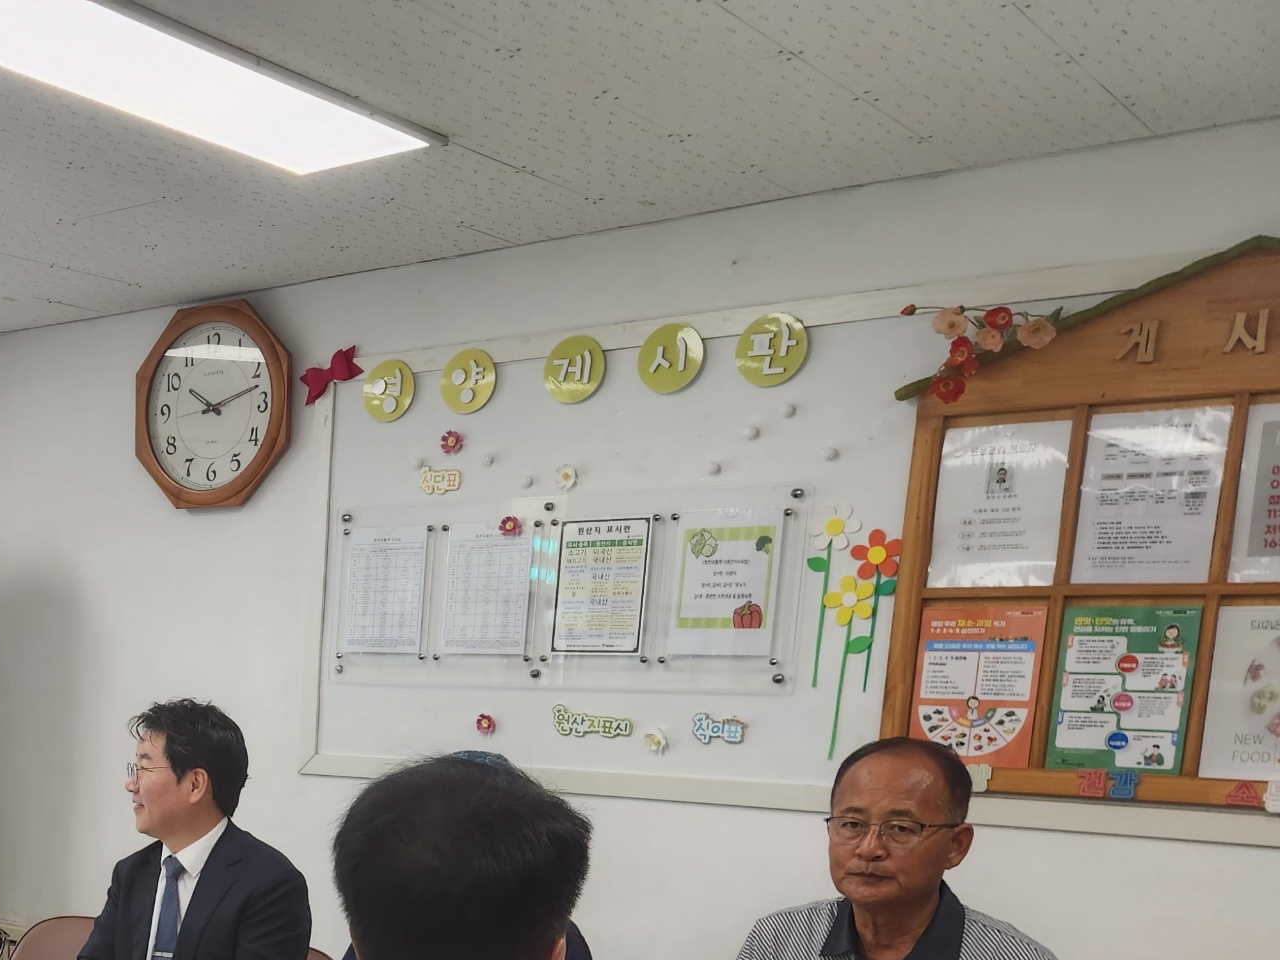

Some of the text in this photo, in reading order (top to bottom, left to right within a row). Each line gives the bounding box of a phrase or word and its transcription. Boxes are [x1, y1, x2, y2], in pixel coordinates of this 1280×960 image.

[207, 332, 221, 355] 12
[553, 323, 797, 384] 게시판
[251, 360, 261, 379] 2
[166, 372, 181, 392] 10
[257, 391, 269, 413] 3
[160, 404, 171, 424] 9
[165, 435, 177, 455] 8
[248, 426, 259, 446] 4
[184, 458, 195, 477] 7
[206, 462, 217, 481] 6
[230, 452, 241, 471] 5
[421, 470, 458, 492] 식단표
[578, 525, 631, 535] 원산지 표시판
[592, 556, 612, 564] 국내산
[555, 710, 630, 735] 원산지표시
[695, 717, 739, 741] 식이표
[1234, 733, 1265, 745] NEW
[1231, 751, 1271, 763] FOOD
[1078, 768, 1139, 799] 건강
